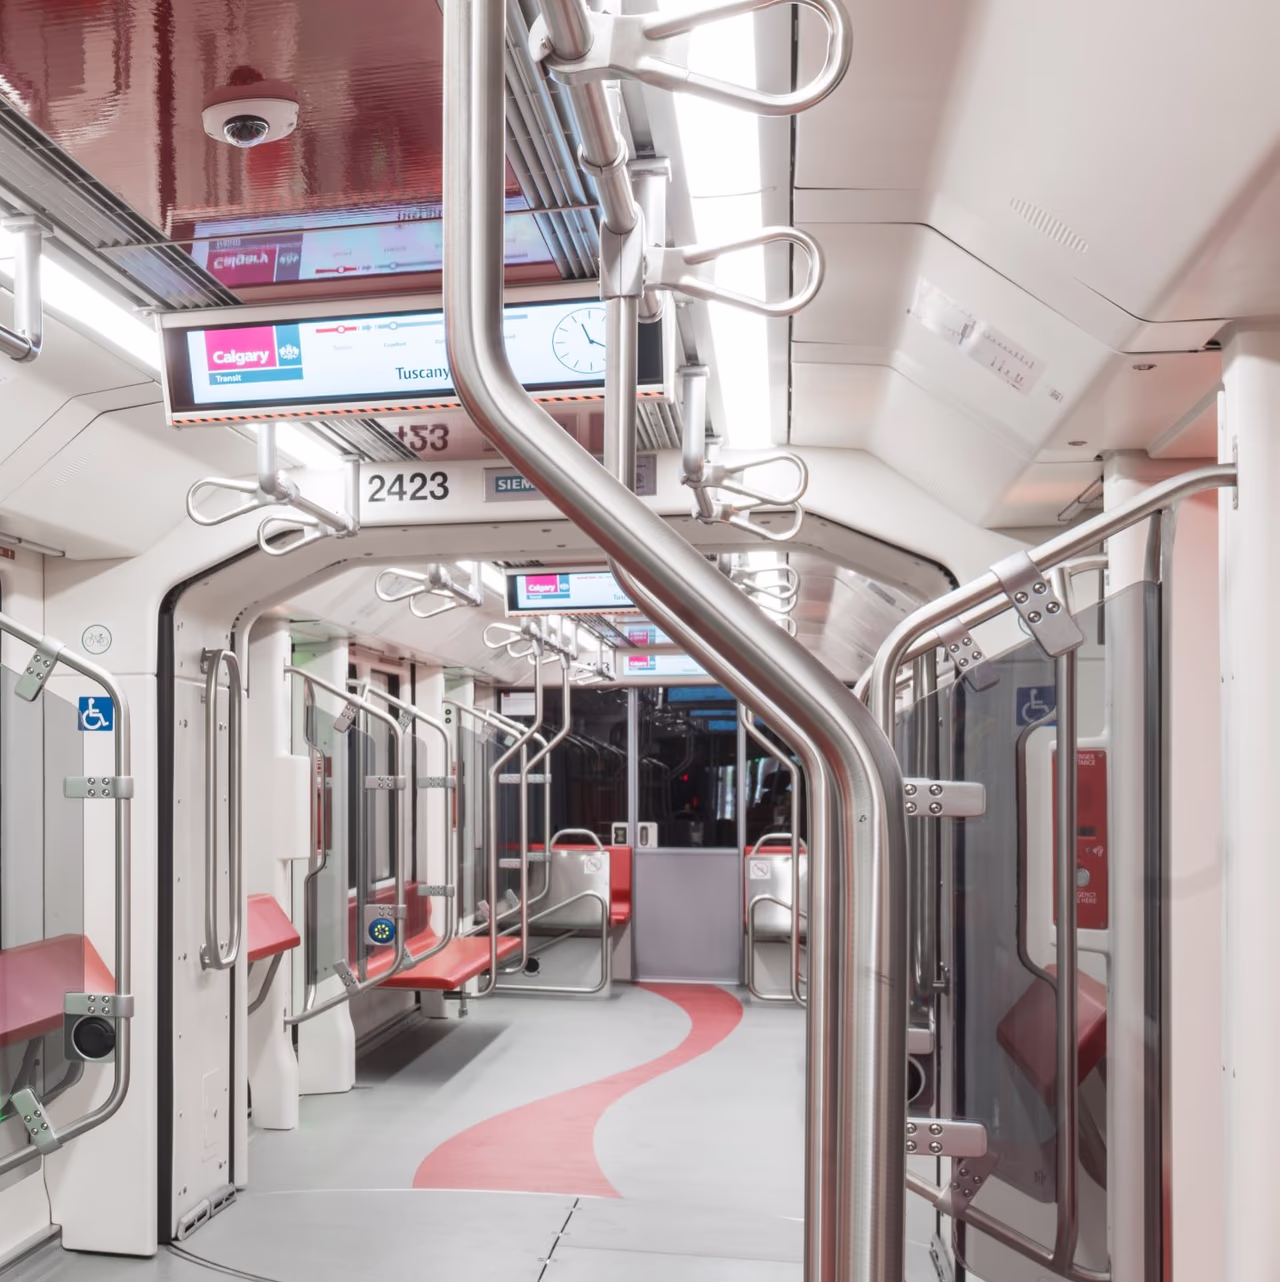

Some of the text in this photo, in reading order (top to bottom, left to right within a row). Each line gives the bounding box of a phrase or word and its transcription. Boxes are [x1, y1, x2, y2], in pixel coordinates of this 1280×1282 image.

[213, 349, 269, 366] Calgary
[216, 374, 242, 383] Transit
[395, 365, 450, 381] Tuscany
[368, 471, 450, 502] 2423
[497, 478, 535, 491] SIEM
